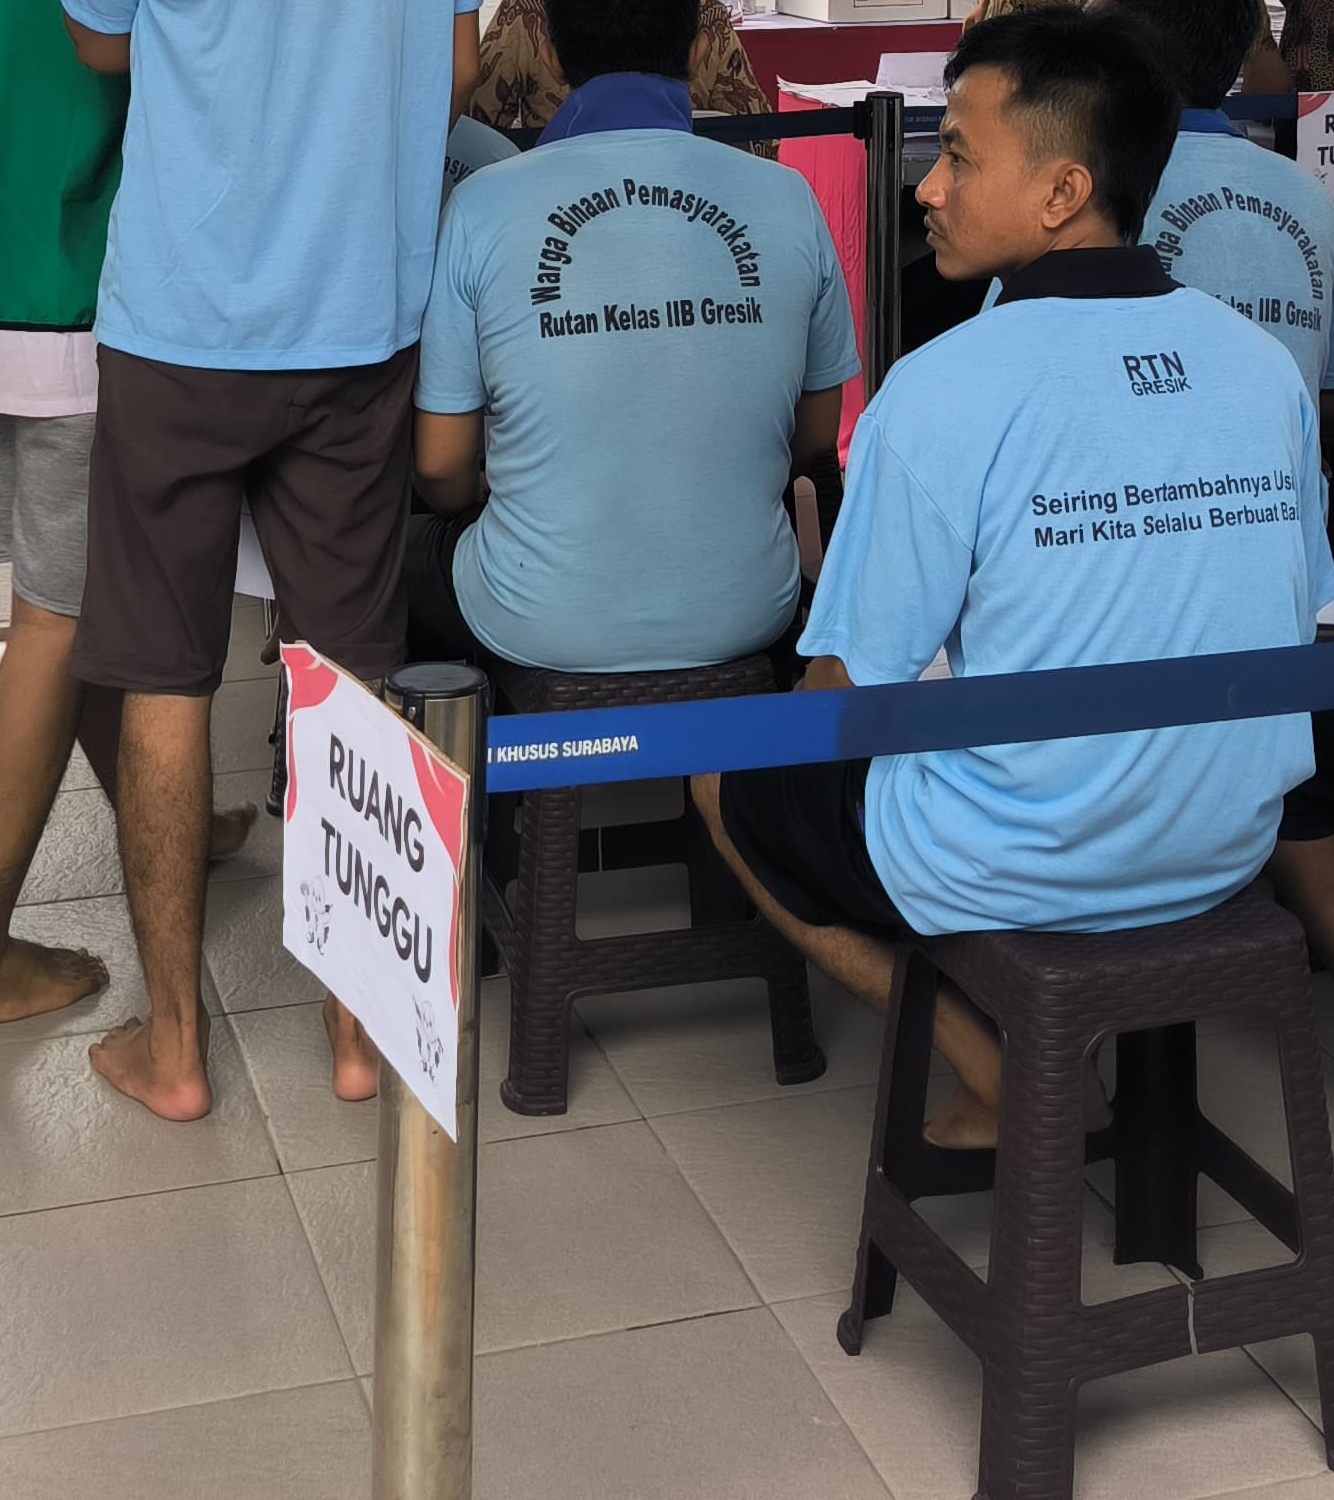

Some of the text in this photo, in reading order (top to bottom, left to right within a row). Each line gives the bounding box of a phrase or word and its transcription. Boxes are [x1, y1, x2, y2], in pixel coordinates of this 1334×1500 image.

[530, 178, 761, 306] Warga Binaan Pemasyarakatan
[1160, 192, 1223, 233] Binaan
[1220, 186, 1324, 301] Pemasyarakatan
[539, 296, 763, 339] Rutan Kelas IIB Gresik
[1258, 297, 1281, 324] IIB
[1285, 300, 1322, 332] Gresik
[1122, 350, 1186, 382] RTN
[1131, 376, 1193, 397] GRESIK
[1031, 469, 1296, 517] Seiring Bertambahnya Usi
[1034, 501, 1300, 548] Mari Kita Selalu Berbuat Bai
[496, 742, 559, 764] KHUSUS
[562, 735, 640, 758] SURABAYA
[329, 731, 425, 874] RUANG
[320, 817, 433, 985] TUNGGU
